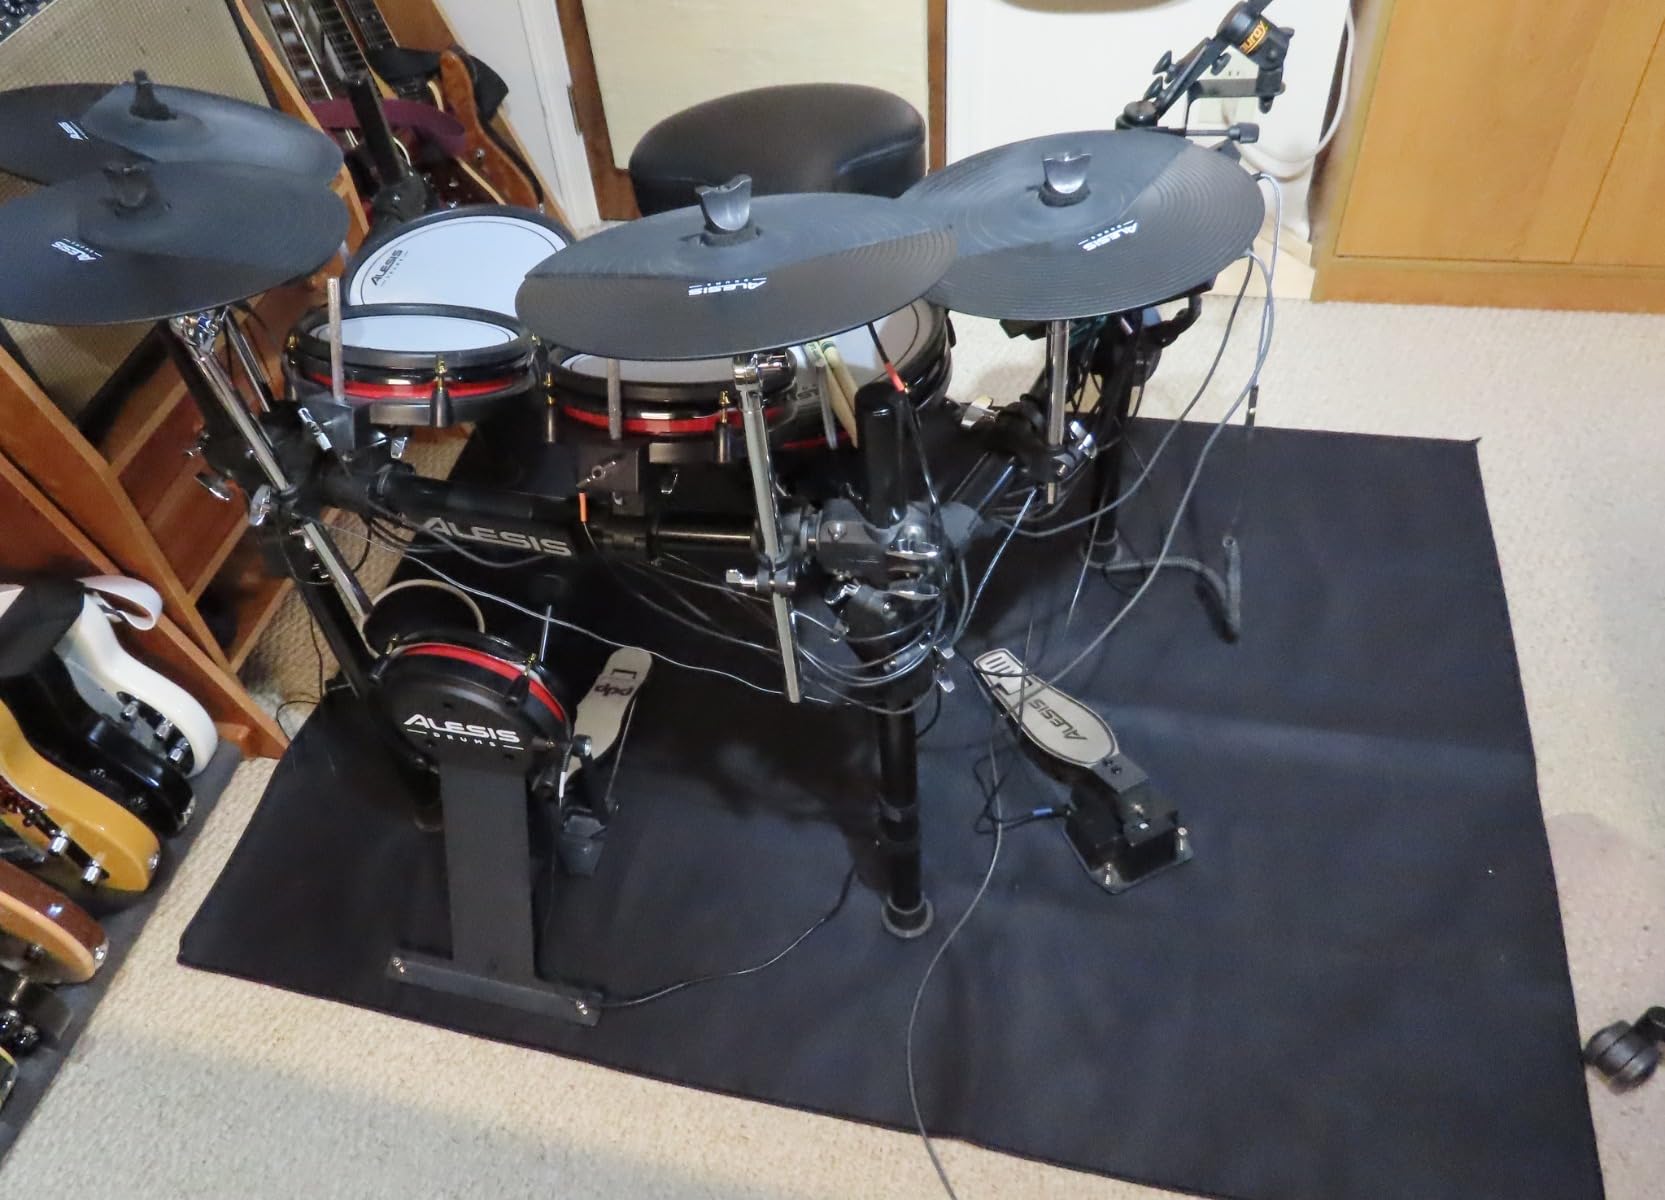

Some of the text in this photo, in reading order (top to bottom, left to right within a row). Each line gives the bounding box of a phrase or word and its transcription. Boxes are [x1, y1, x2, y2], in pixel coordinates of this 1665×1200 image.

[371, 249, 403, 286] ALESIS
[423, 517, 572, 557] ALESIS
[594, 683, 635, 697] pdp
[403, 713, 520, 743] ALESIS
[1027, 698, 1088, 741] ALESIS
